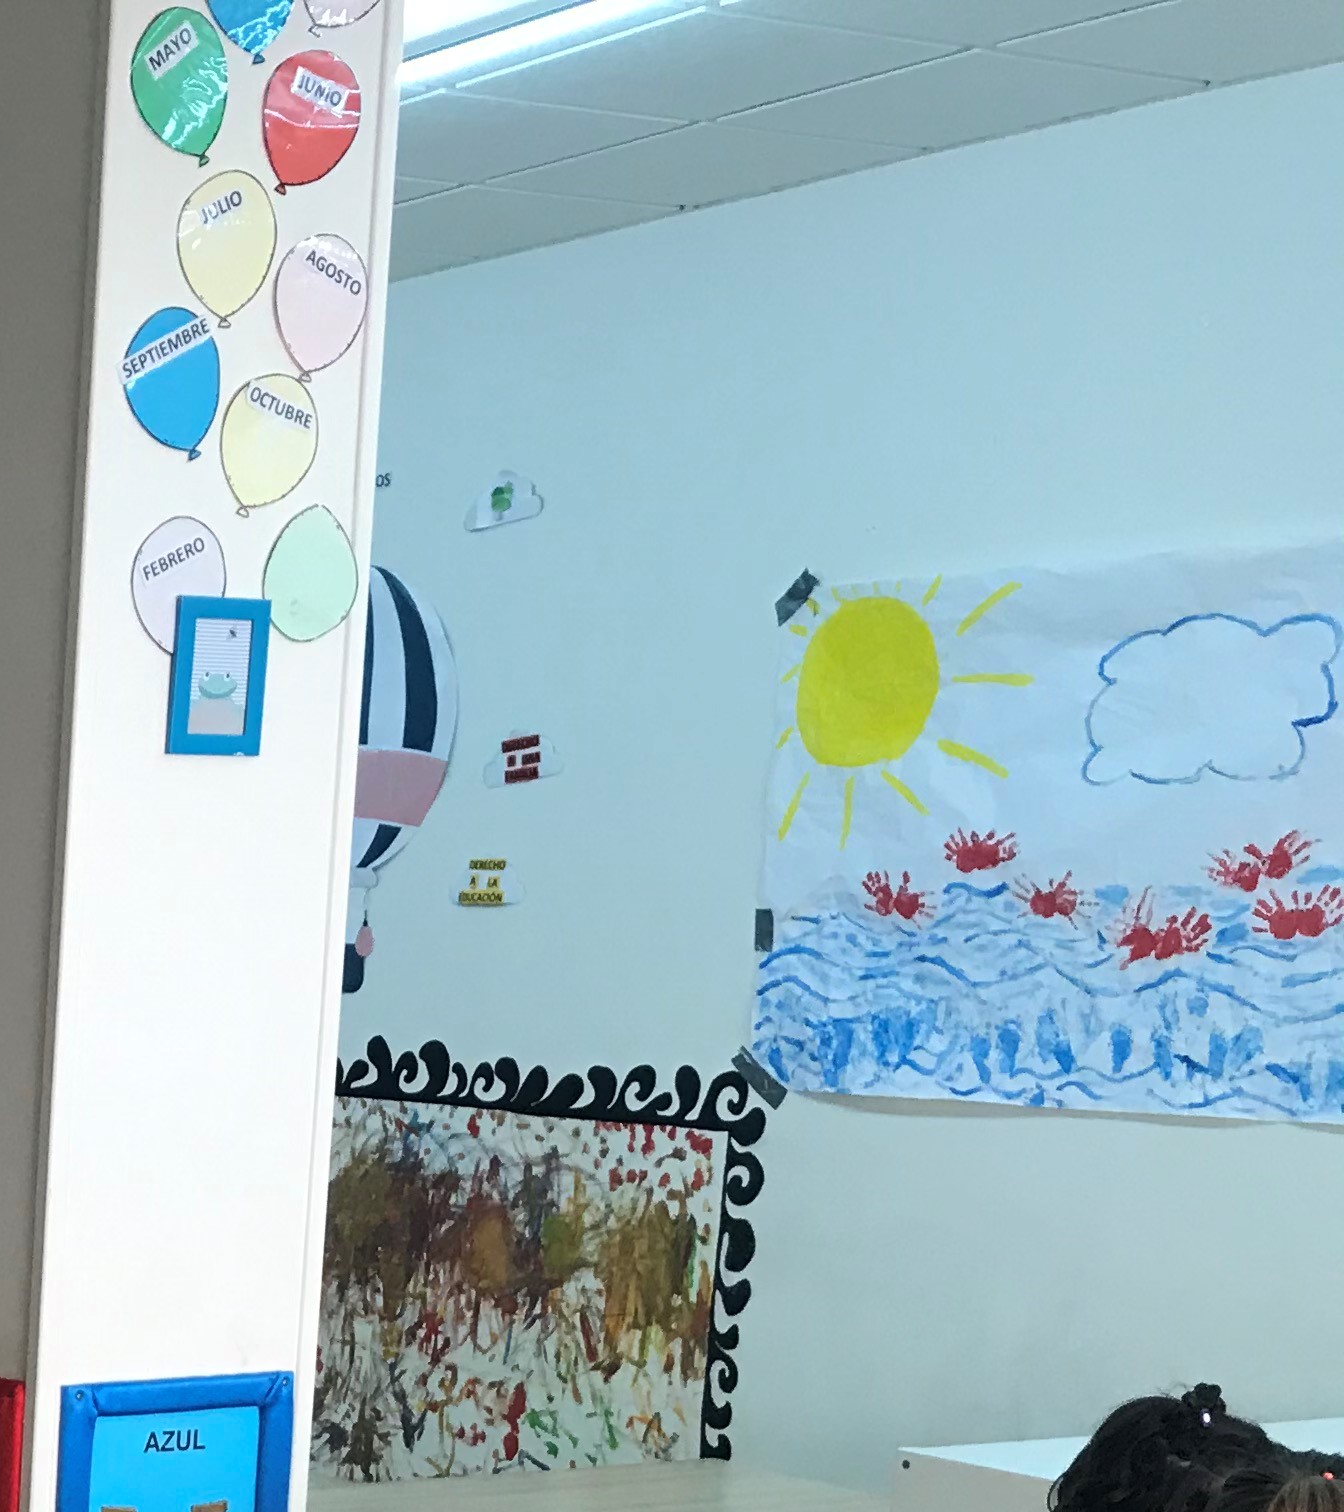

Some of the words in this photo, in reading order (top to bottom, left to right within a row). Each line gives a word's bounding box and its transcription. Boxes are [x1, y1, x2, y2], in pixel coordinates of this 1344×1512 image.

[148, 27, 192, 70] MAYO
[297, 75, 342, 106] JUNIO
[201, 190, 243, 225] JULIO
[305, 250, 362, 296] AGOSTO
[122, 318, 210, 378] SEPTIEMBRE
[250, 387, 312, 429] OCTUBRE
[376, 472, 391, 488] OS
[143, 537, 205, 582] FEBRERO
[144, 1429, 206, 1454] AZUL
